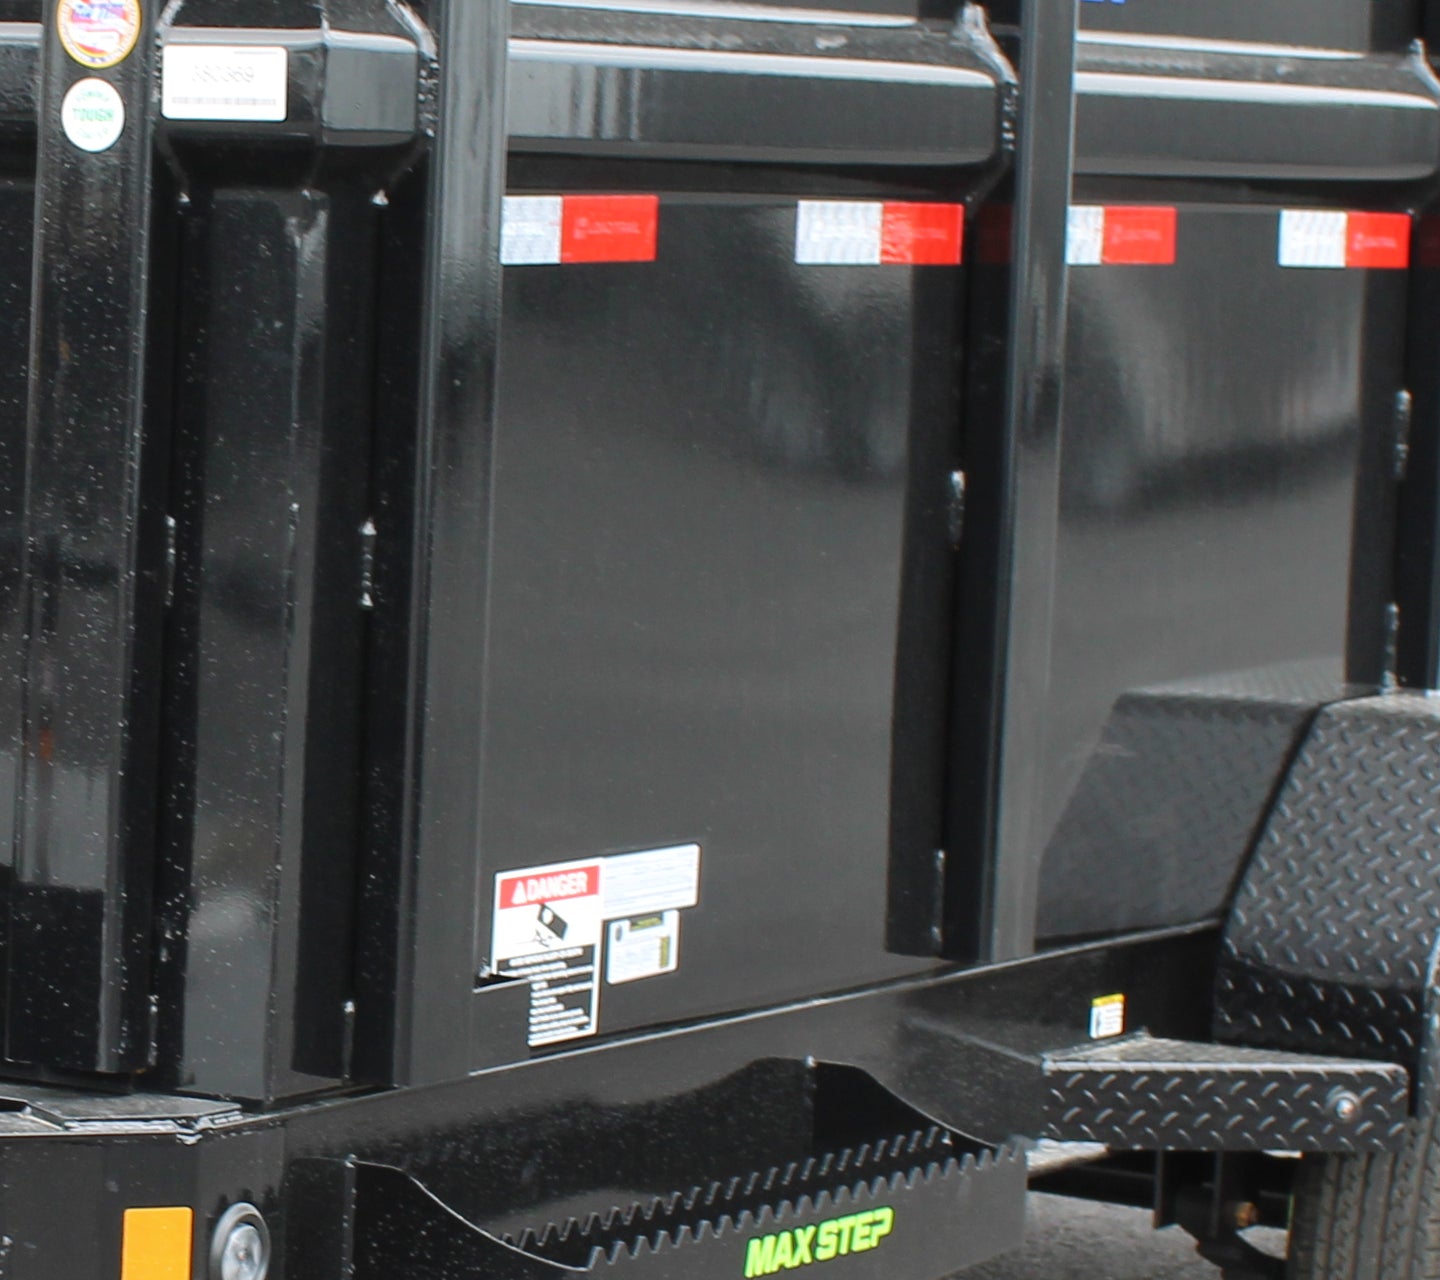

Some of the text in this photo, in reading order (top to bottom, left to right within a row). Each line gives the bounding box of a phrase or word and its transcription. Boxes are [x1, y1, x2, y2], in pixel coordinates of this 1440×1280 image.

[526, 871, 589, 899] DANGER
[744, 1206, 895, 1279] MAX STEP
